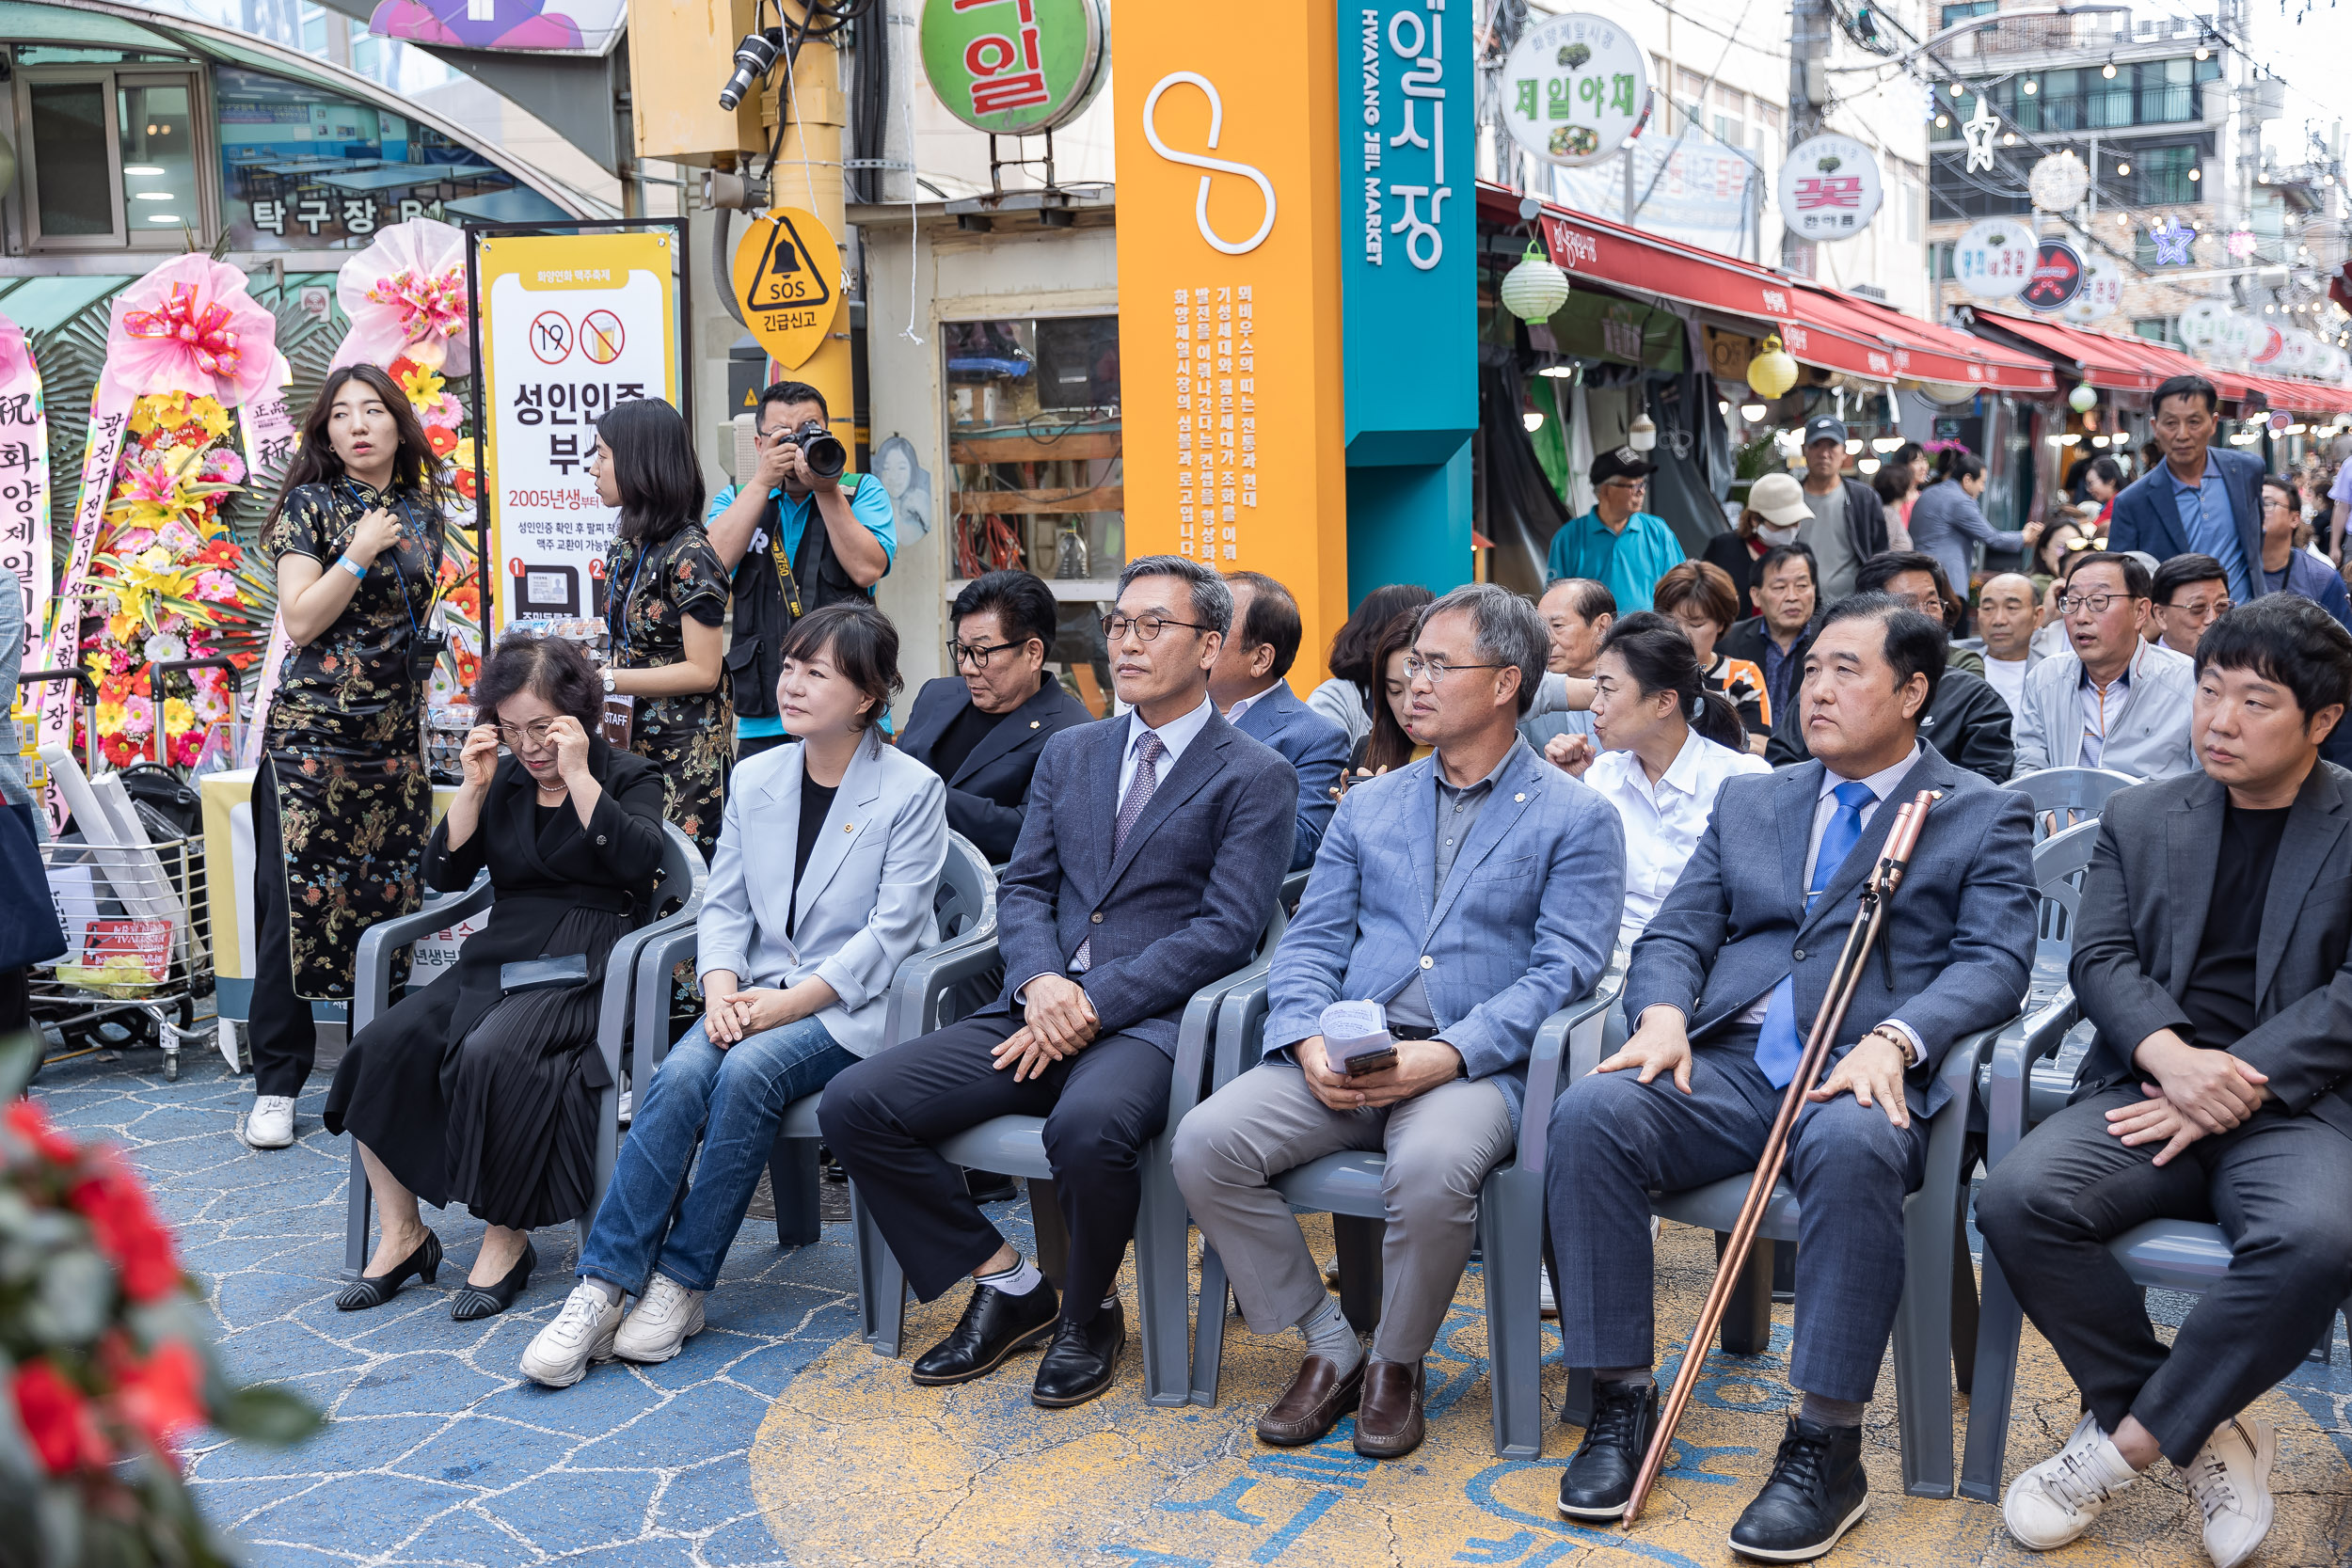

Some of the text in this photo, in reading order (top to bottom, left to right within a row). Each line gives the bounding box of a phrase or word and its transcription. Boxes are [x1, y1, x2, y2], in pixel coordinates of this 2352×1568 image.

[1516, 73, 1635, 120] 제일야채
[1361, 9, 1382, 266] HWAYANG JEIL MARKET
[1388, 0, 1452, 270] 일시장
[1794, 177, 1863, 210] 꽃
[252, 198, 376, 235] 탁구장
[537, 268, 611, 283] 화양연화 맥주축제
[771, 281, 805, 299] SOS
[763, 311, 817, 332] 긴급신고
[1195, 287, 1211, 341] 발전을
[1216, 286, 1233, 374] 기성세대와
[1238, 285, 1254, 374] 뫼비우스의
[537, 325, 564, 351] 19
[0, 393, 37, 427] 祝
[1174, 288, 1196, 557] 화양제일시장의 심볼과 로고입니다
[1241, 417, 1257, 468] 전통과
[1200, 452, 1215, 506] 컨셉을
[1220, 470, 1236, 522] 조화를
[1242, 473, 1257, 508] 현대
[518, 522, 554, 534] 성인인증
[556, 522, 574, 534] 확인
[575, 523, 585, 534] 후
[586, 522, 605, 534] 팔찌
[537, 540, 555, 551] 맥주
[556, 540, 583, 551] 교환이
[1221, 526, 1237, 561] 이뤄
[774, 552, 790, 577] D750
[604, 711, 628, 726] STAFF
